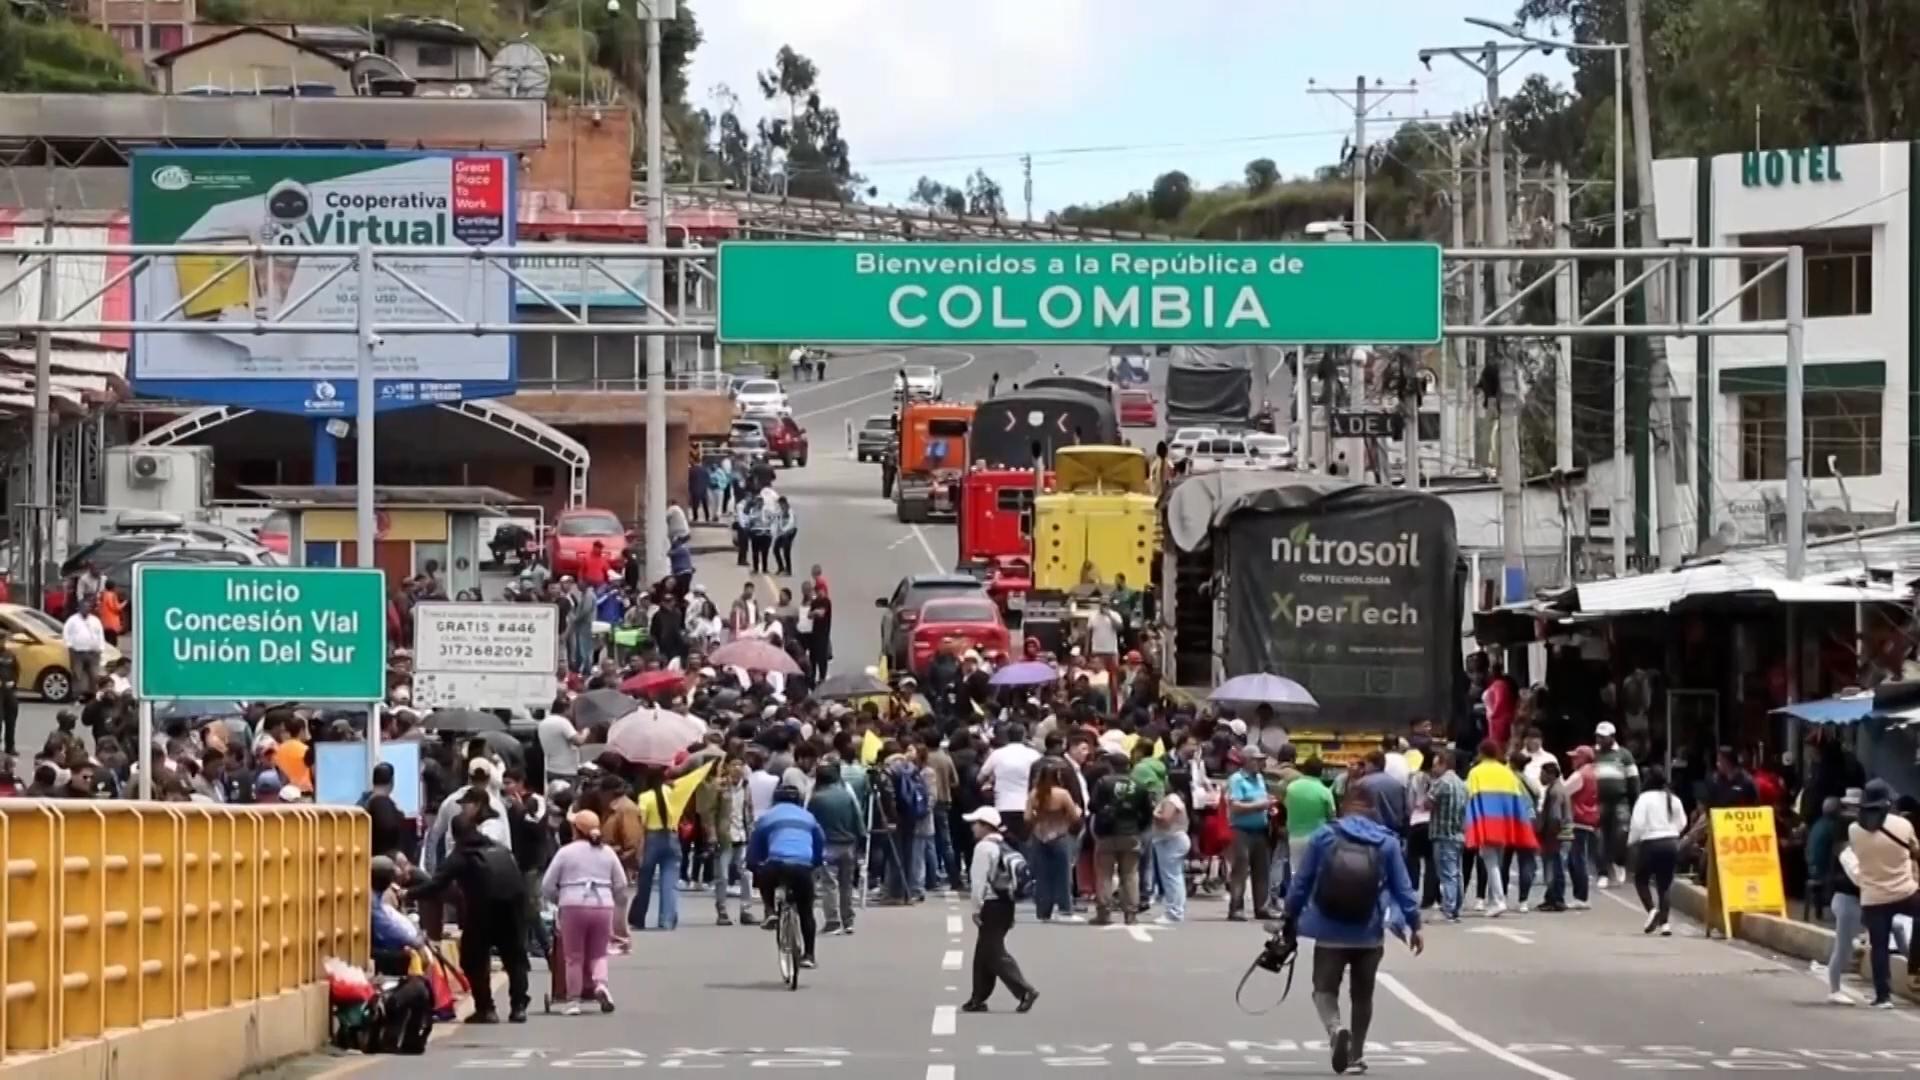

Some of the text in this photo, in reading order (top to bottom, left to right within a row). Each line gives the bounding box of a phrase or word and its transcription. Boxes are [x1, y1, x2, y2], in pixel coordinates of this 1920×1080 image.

[455, 161, 491, 172] Great
[1741, 145, 1843, 187] HOTEL
[455, 173, 490, 185] Place
[455, 185, 469, 197] To
[325, 191, 447, 210] Cooperativa
[455, 197, 487, 209] Work
[307, 212, 446, 246] Virtual
[856, 253, 1304, 279] Bienvenidos a la República de
[889, 285, 1270, 328] COLOMBIA
[1349, 417, 1379, 434] DE
[1271, 530, 1420, 567] nitrosoil
[1299, 573, 1323, 583] CON
[228, 579, 300, 602] Inicio
[1270, 591, 1418, 628] XperTech
[165, 607, 359, 633] Concesión Vial
[436, 621, 536, 634] GRATIS #446
[173, 637, 355, 663] Unión Del Sur
[439, 645, 534, 658] 3173682092
[1736, 823, 1755, 832] SU
[1719, 834, 1772, 855] SOAT
[1040, 1055, 1428, 1066] SOLO
[1611, 1059, 1920, 1073] SOL
